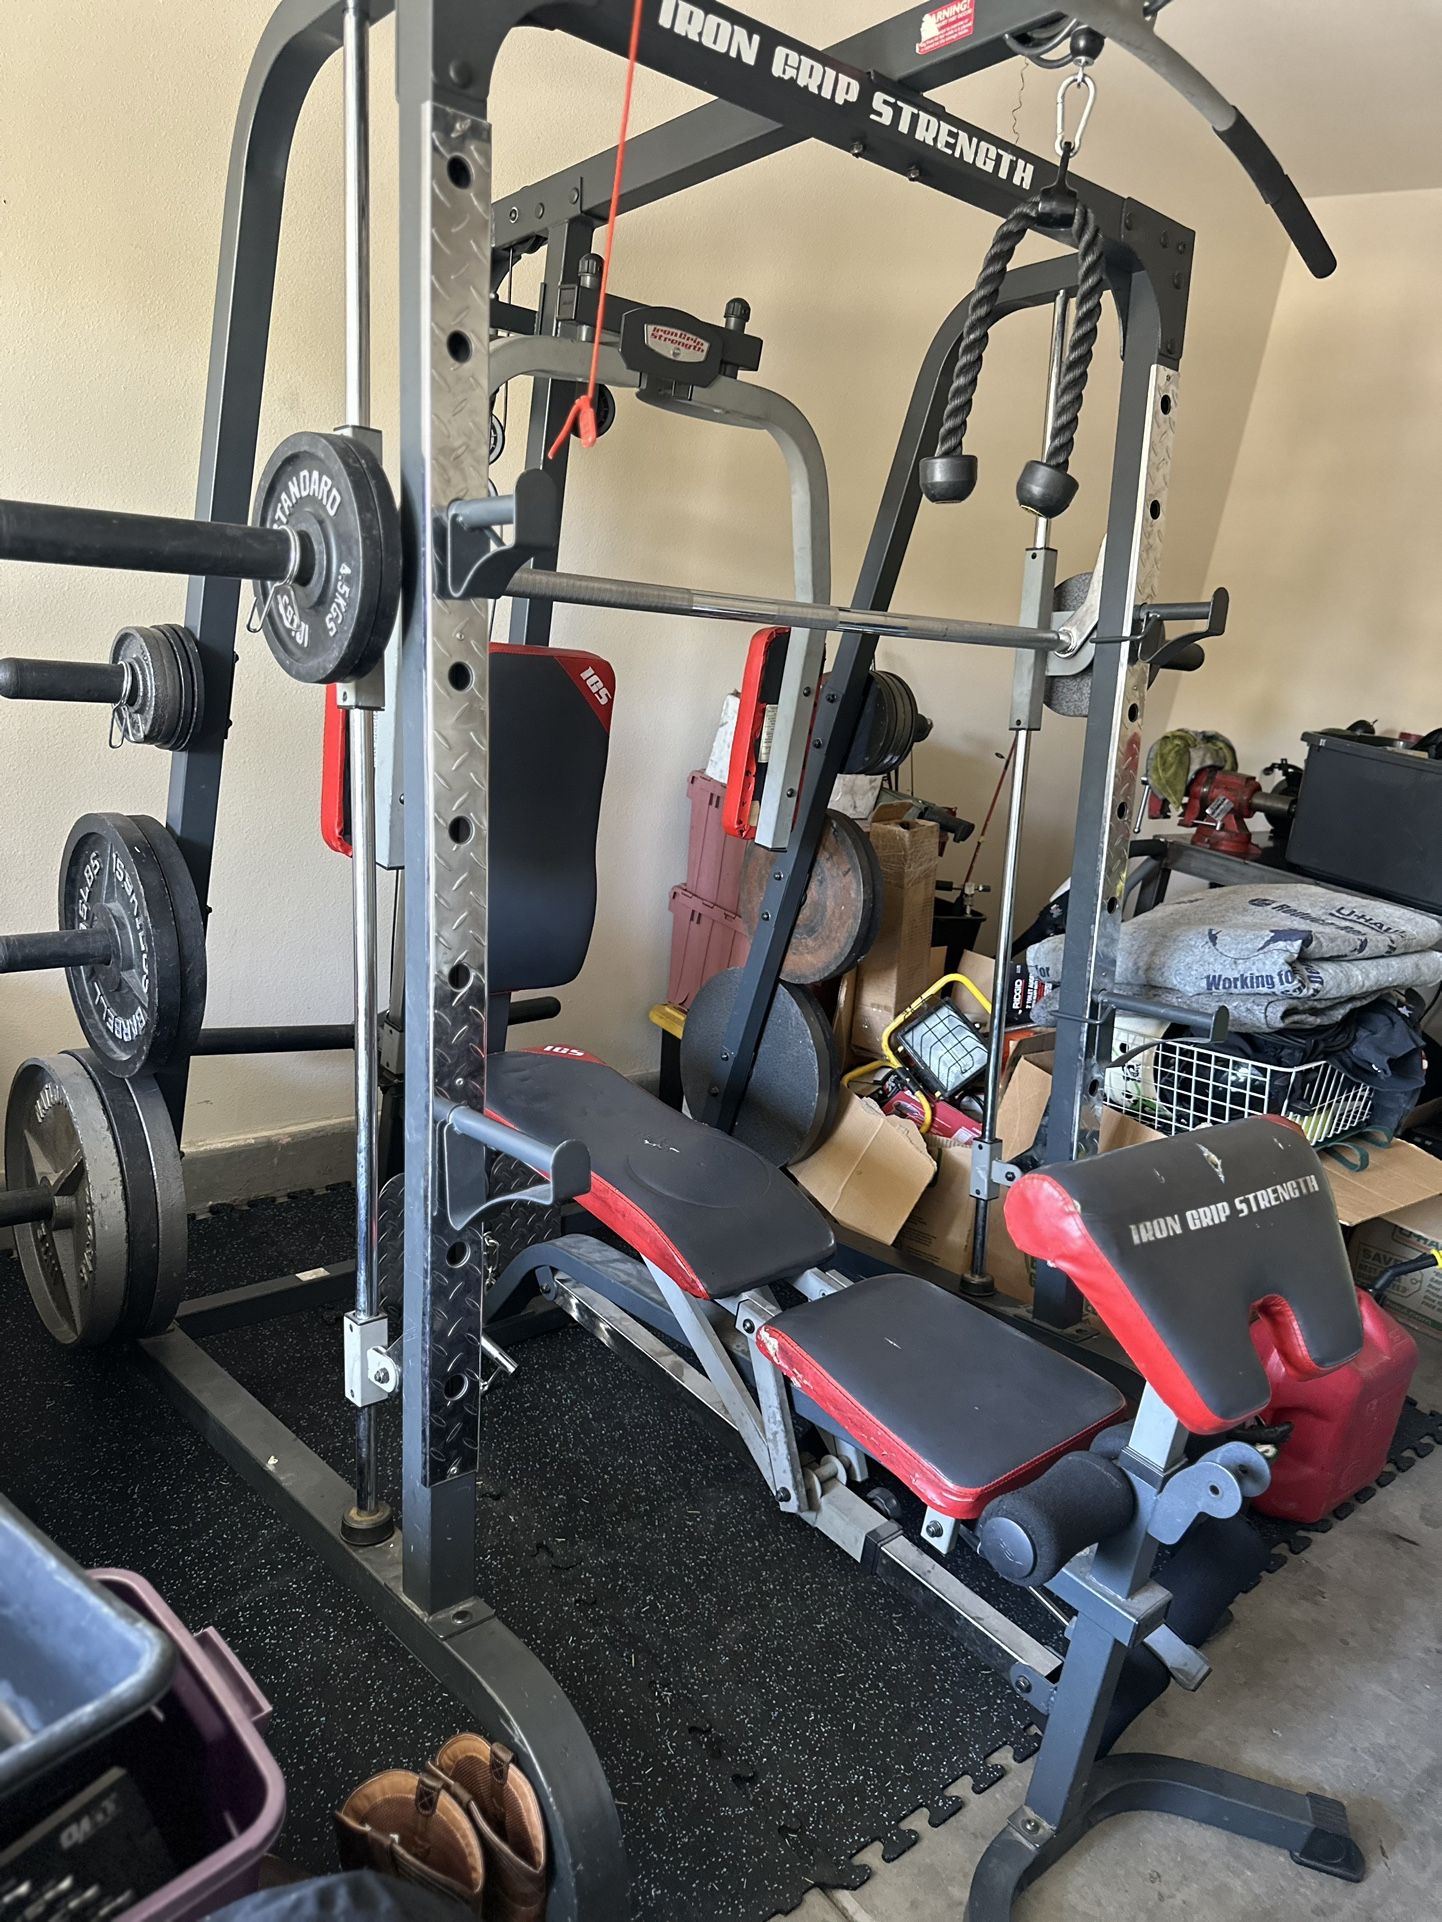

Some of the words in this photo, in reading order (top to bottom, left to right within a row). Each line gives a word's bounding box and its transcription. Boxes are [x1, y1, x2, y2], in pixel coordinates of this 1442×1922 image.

[930, 0, 972, 22] ARNING!
[658, 0, 760, 66] IRON
[771, 46, 860, 105] GRIP
[869, 91, 1034, 190] STRENGTH
[1012, 978, 1023, 1009] RIDGID
[1205, 973, 1275, 991] Working
[1277, 969, 1294, 986] fo
[1129, 1214, 1183, 1246] IRON
[1185, 1201, 1231, 1231] GRIP
[1234, 1174, 1320, 1218] STRENGTH
